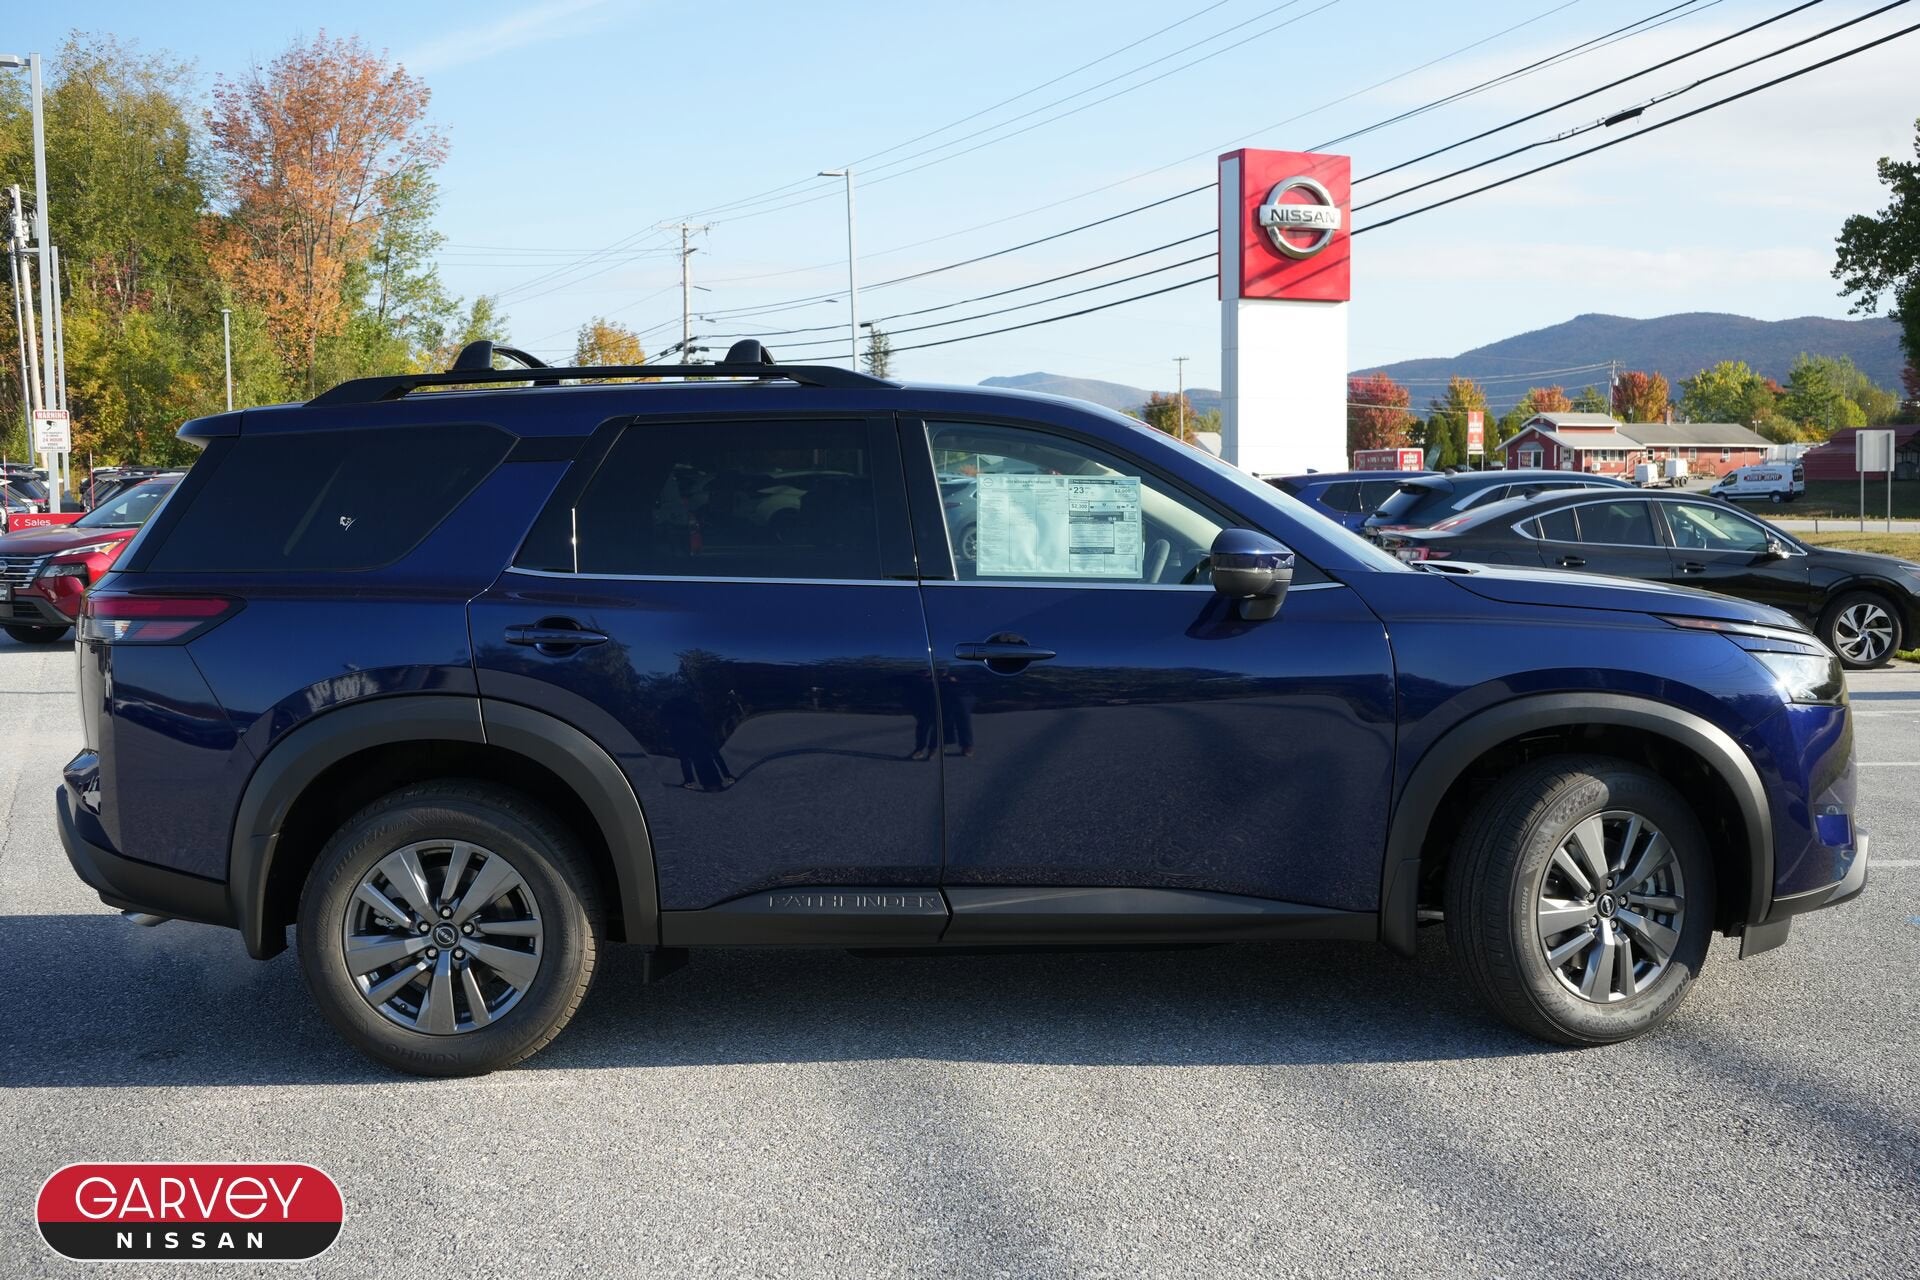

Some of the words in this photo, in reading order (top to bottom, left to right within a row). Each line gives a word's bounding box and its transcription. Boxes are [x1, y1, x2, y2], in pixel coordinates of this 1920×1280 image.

[1270, 208, 1336, 223] NISSAN
[36, 411, 67, 419] WARNING
[1073, 486, 1085, 494] 23
[24, 518, 52, 527] Sales
[769, 894, 939, 908] PATHFINDER
[1521, 886, 1529, 915] 108H
